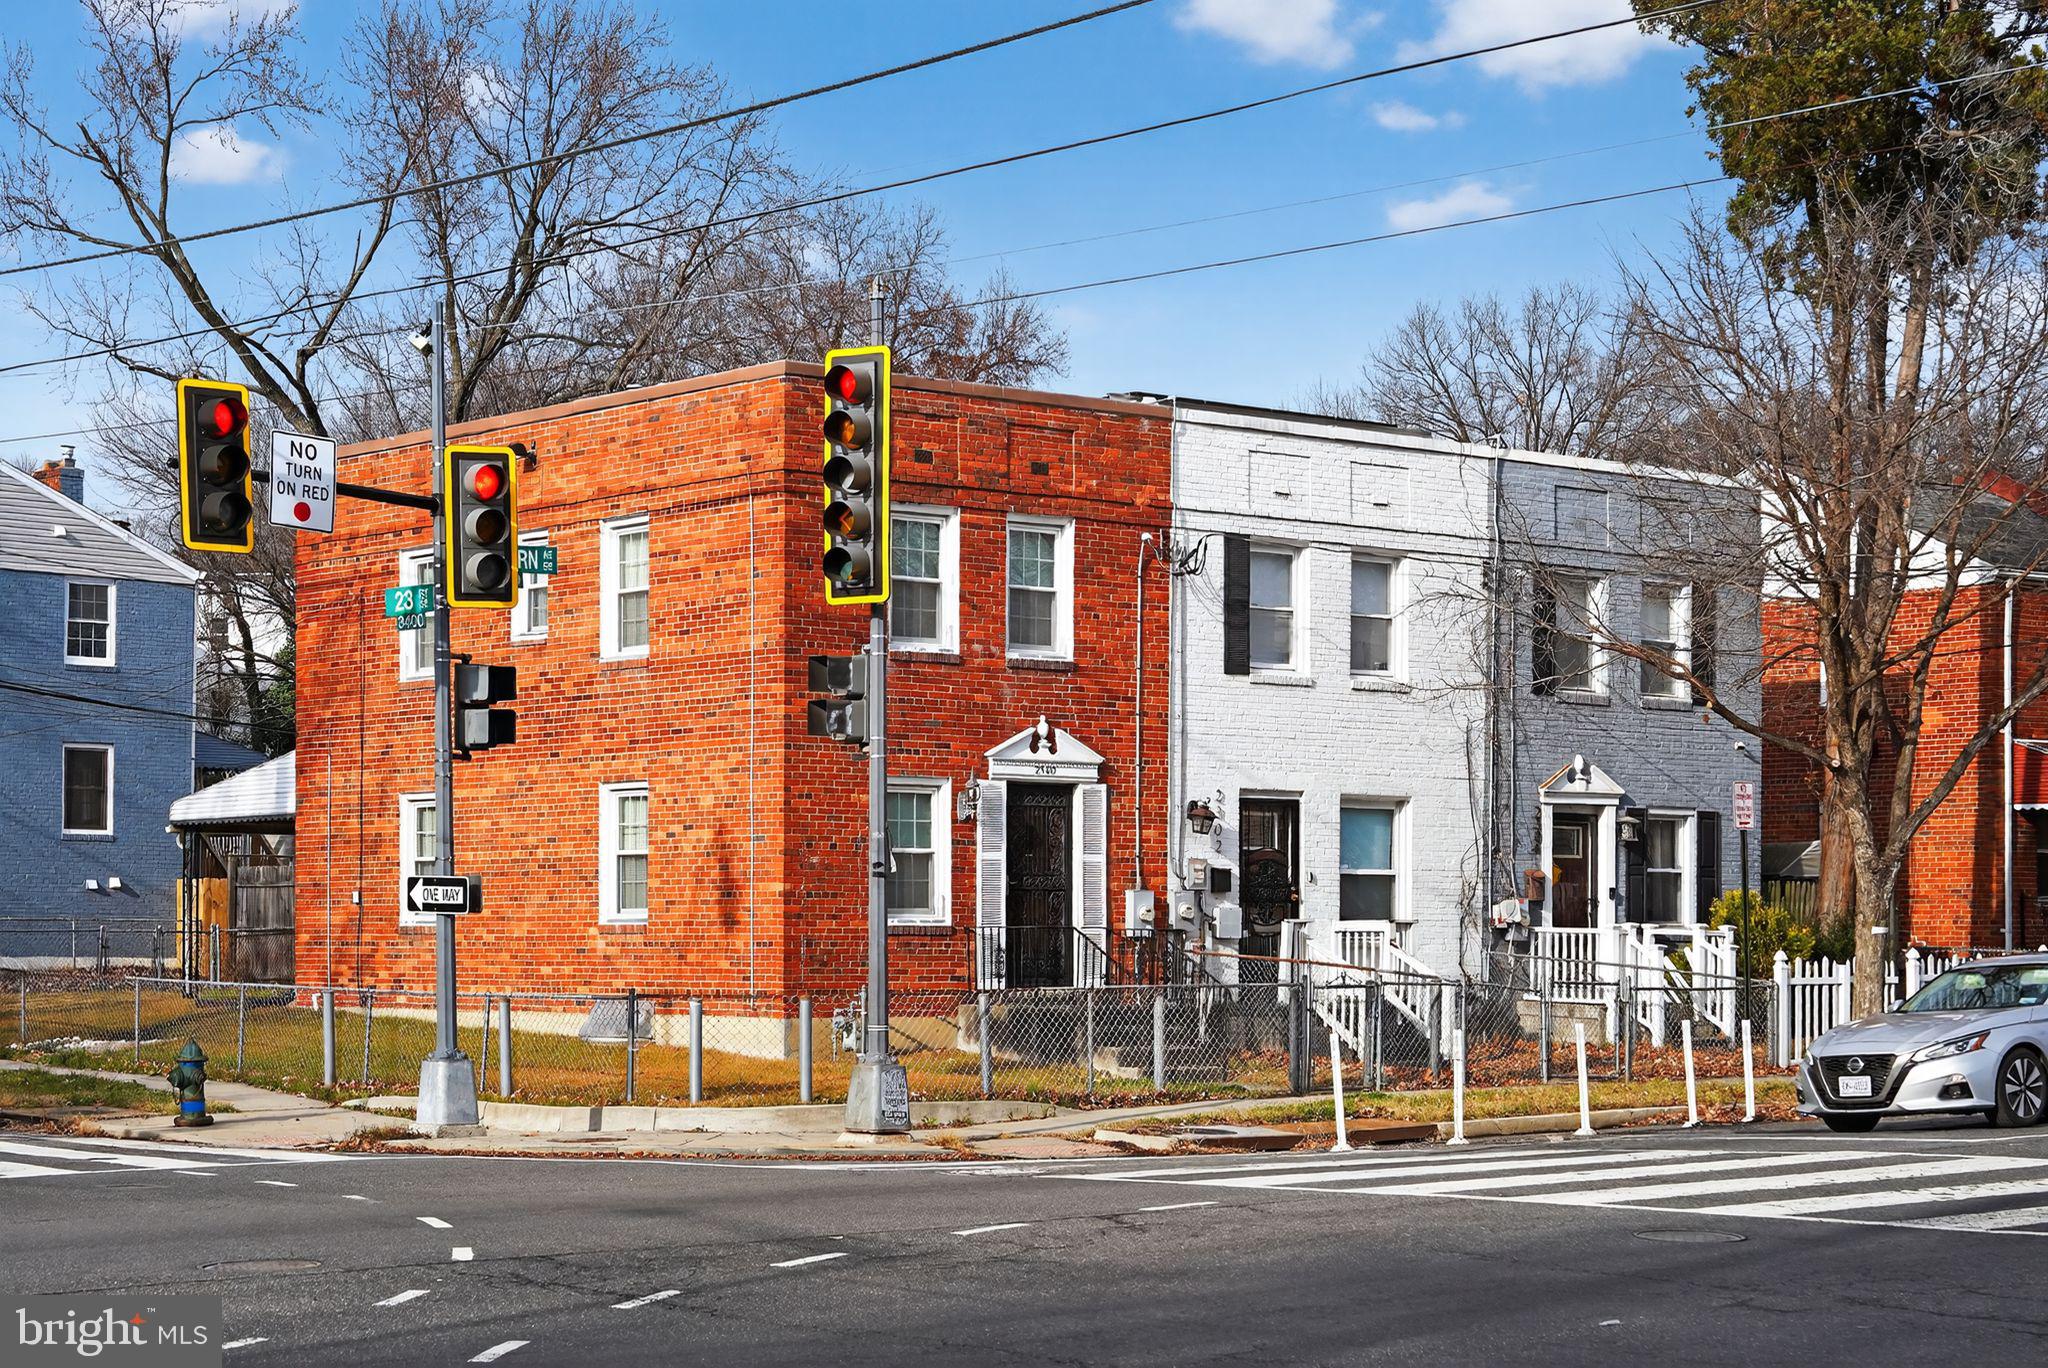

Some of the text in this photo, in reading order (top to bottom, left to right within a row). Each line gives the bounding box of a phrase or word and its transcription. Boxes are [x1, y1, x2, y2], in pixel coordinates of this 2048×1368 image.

[290, 440, 317, 461] NO
[286, 462, 322, 481] TURN
[277, 480, 329, 501] ON RED
[518, 549, 538, 570] RN
[394, 589, 414, 612] 23
[422, 887, 460, 902] ONE WAY
